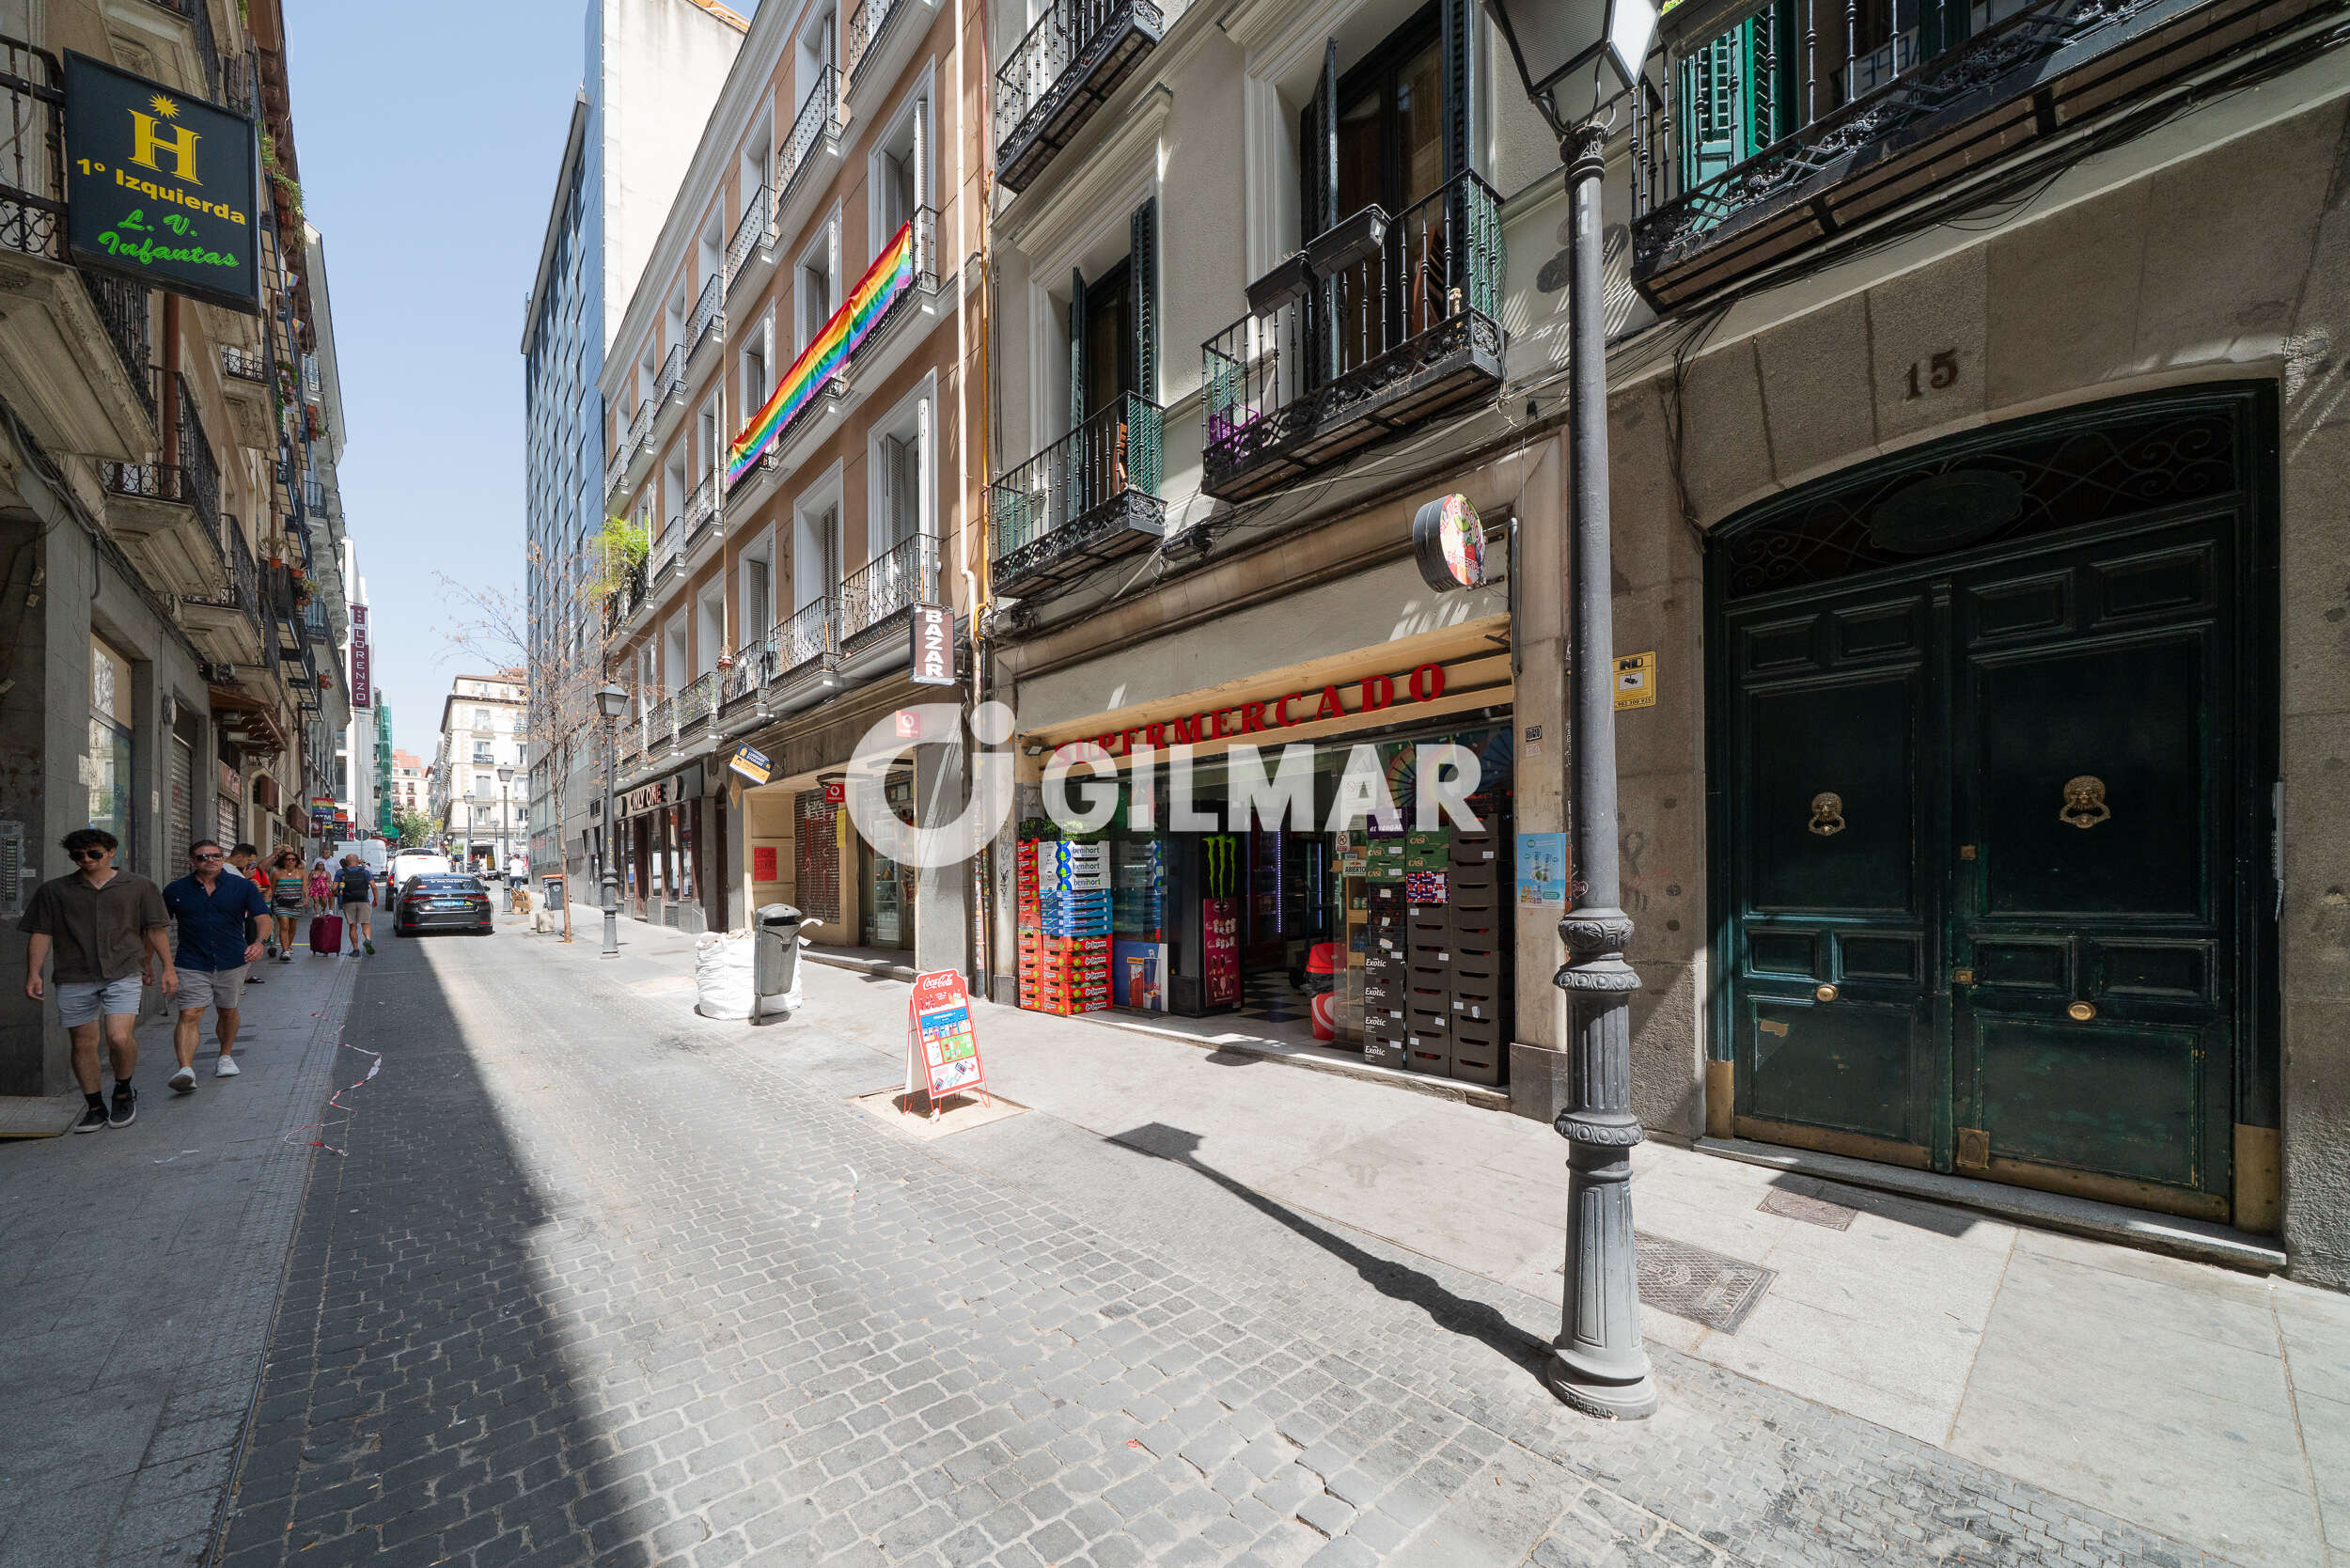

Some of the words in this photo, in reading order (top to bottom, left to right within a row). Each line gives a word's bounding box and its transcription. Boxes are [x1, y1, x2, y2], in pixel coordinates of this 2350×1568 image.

[128, 108, 204, 186] H
[116, 168, 246, 226] Izquierda
[117, 209, 155, 232] L.
[164, 213, 198, 237] V.
[98, 231, 240, 267] Infantas
[1904, 348, 1958, 401] 15
[924, 610, 944, 678] BAZAR
[354, 630, 366, 701] LORENZO
[1054, 662, 1447, 768] SUPERMERCADO
[630, 789, 645, 811] ONLY
[647, 783, 663, 806] ONE
[1366, 959, 1386, 967] Exotic
[923, 974, 953, 990] Coca-Cola
[1365, 988, 1386, 997] Exotic
[1366, 1017, 1386, 1027] Exotic
[1365, 1046, 1386, 1056] Exotic
